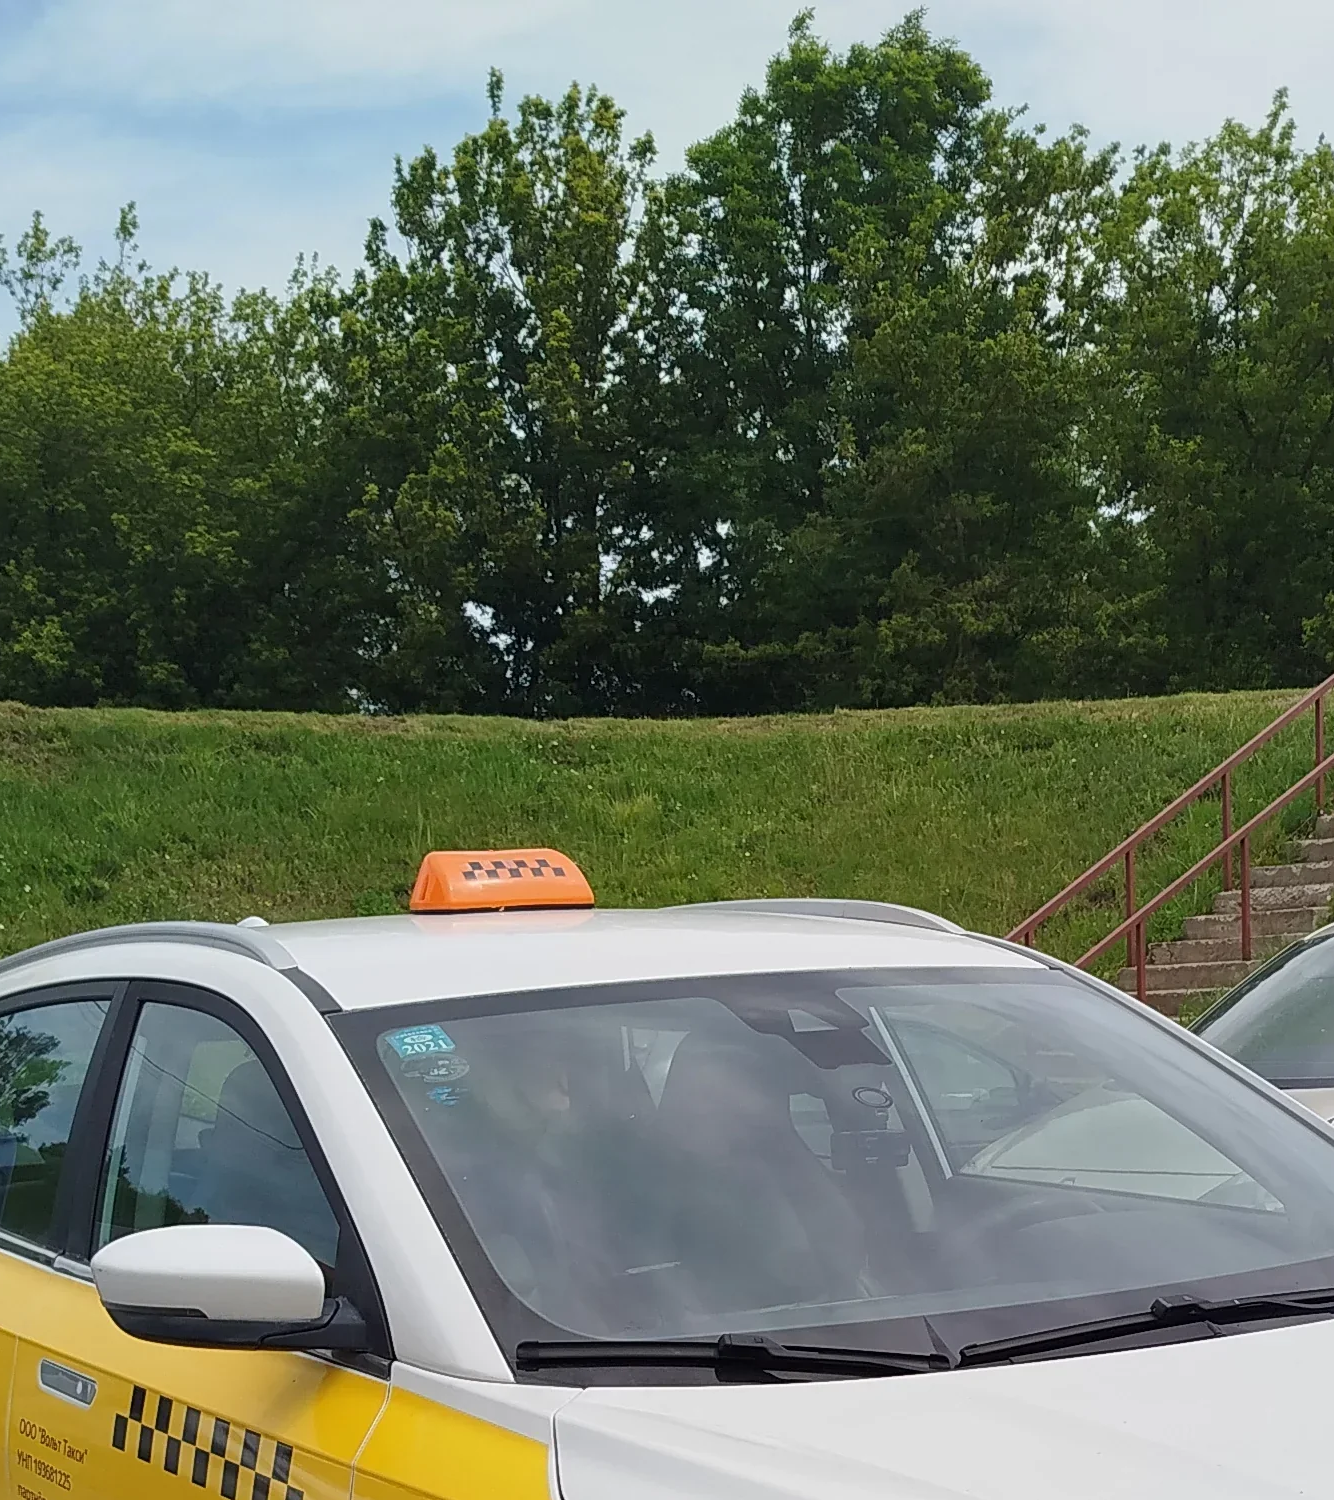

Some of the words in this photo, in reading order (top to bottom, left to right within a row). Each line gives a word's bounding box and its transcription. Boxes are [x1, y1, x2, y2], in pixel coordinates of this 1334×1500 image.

[402, 1039, 452, 1055] 2021
[19, 1418, 37, 1440] ООО
[17, 1449, 33, 1472] УНП
